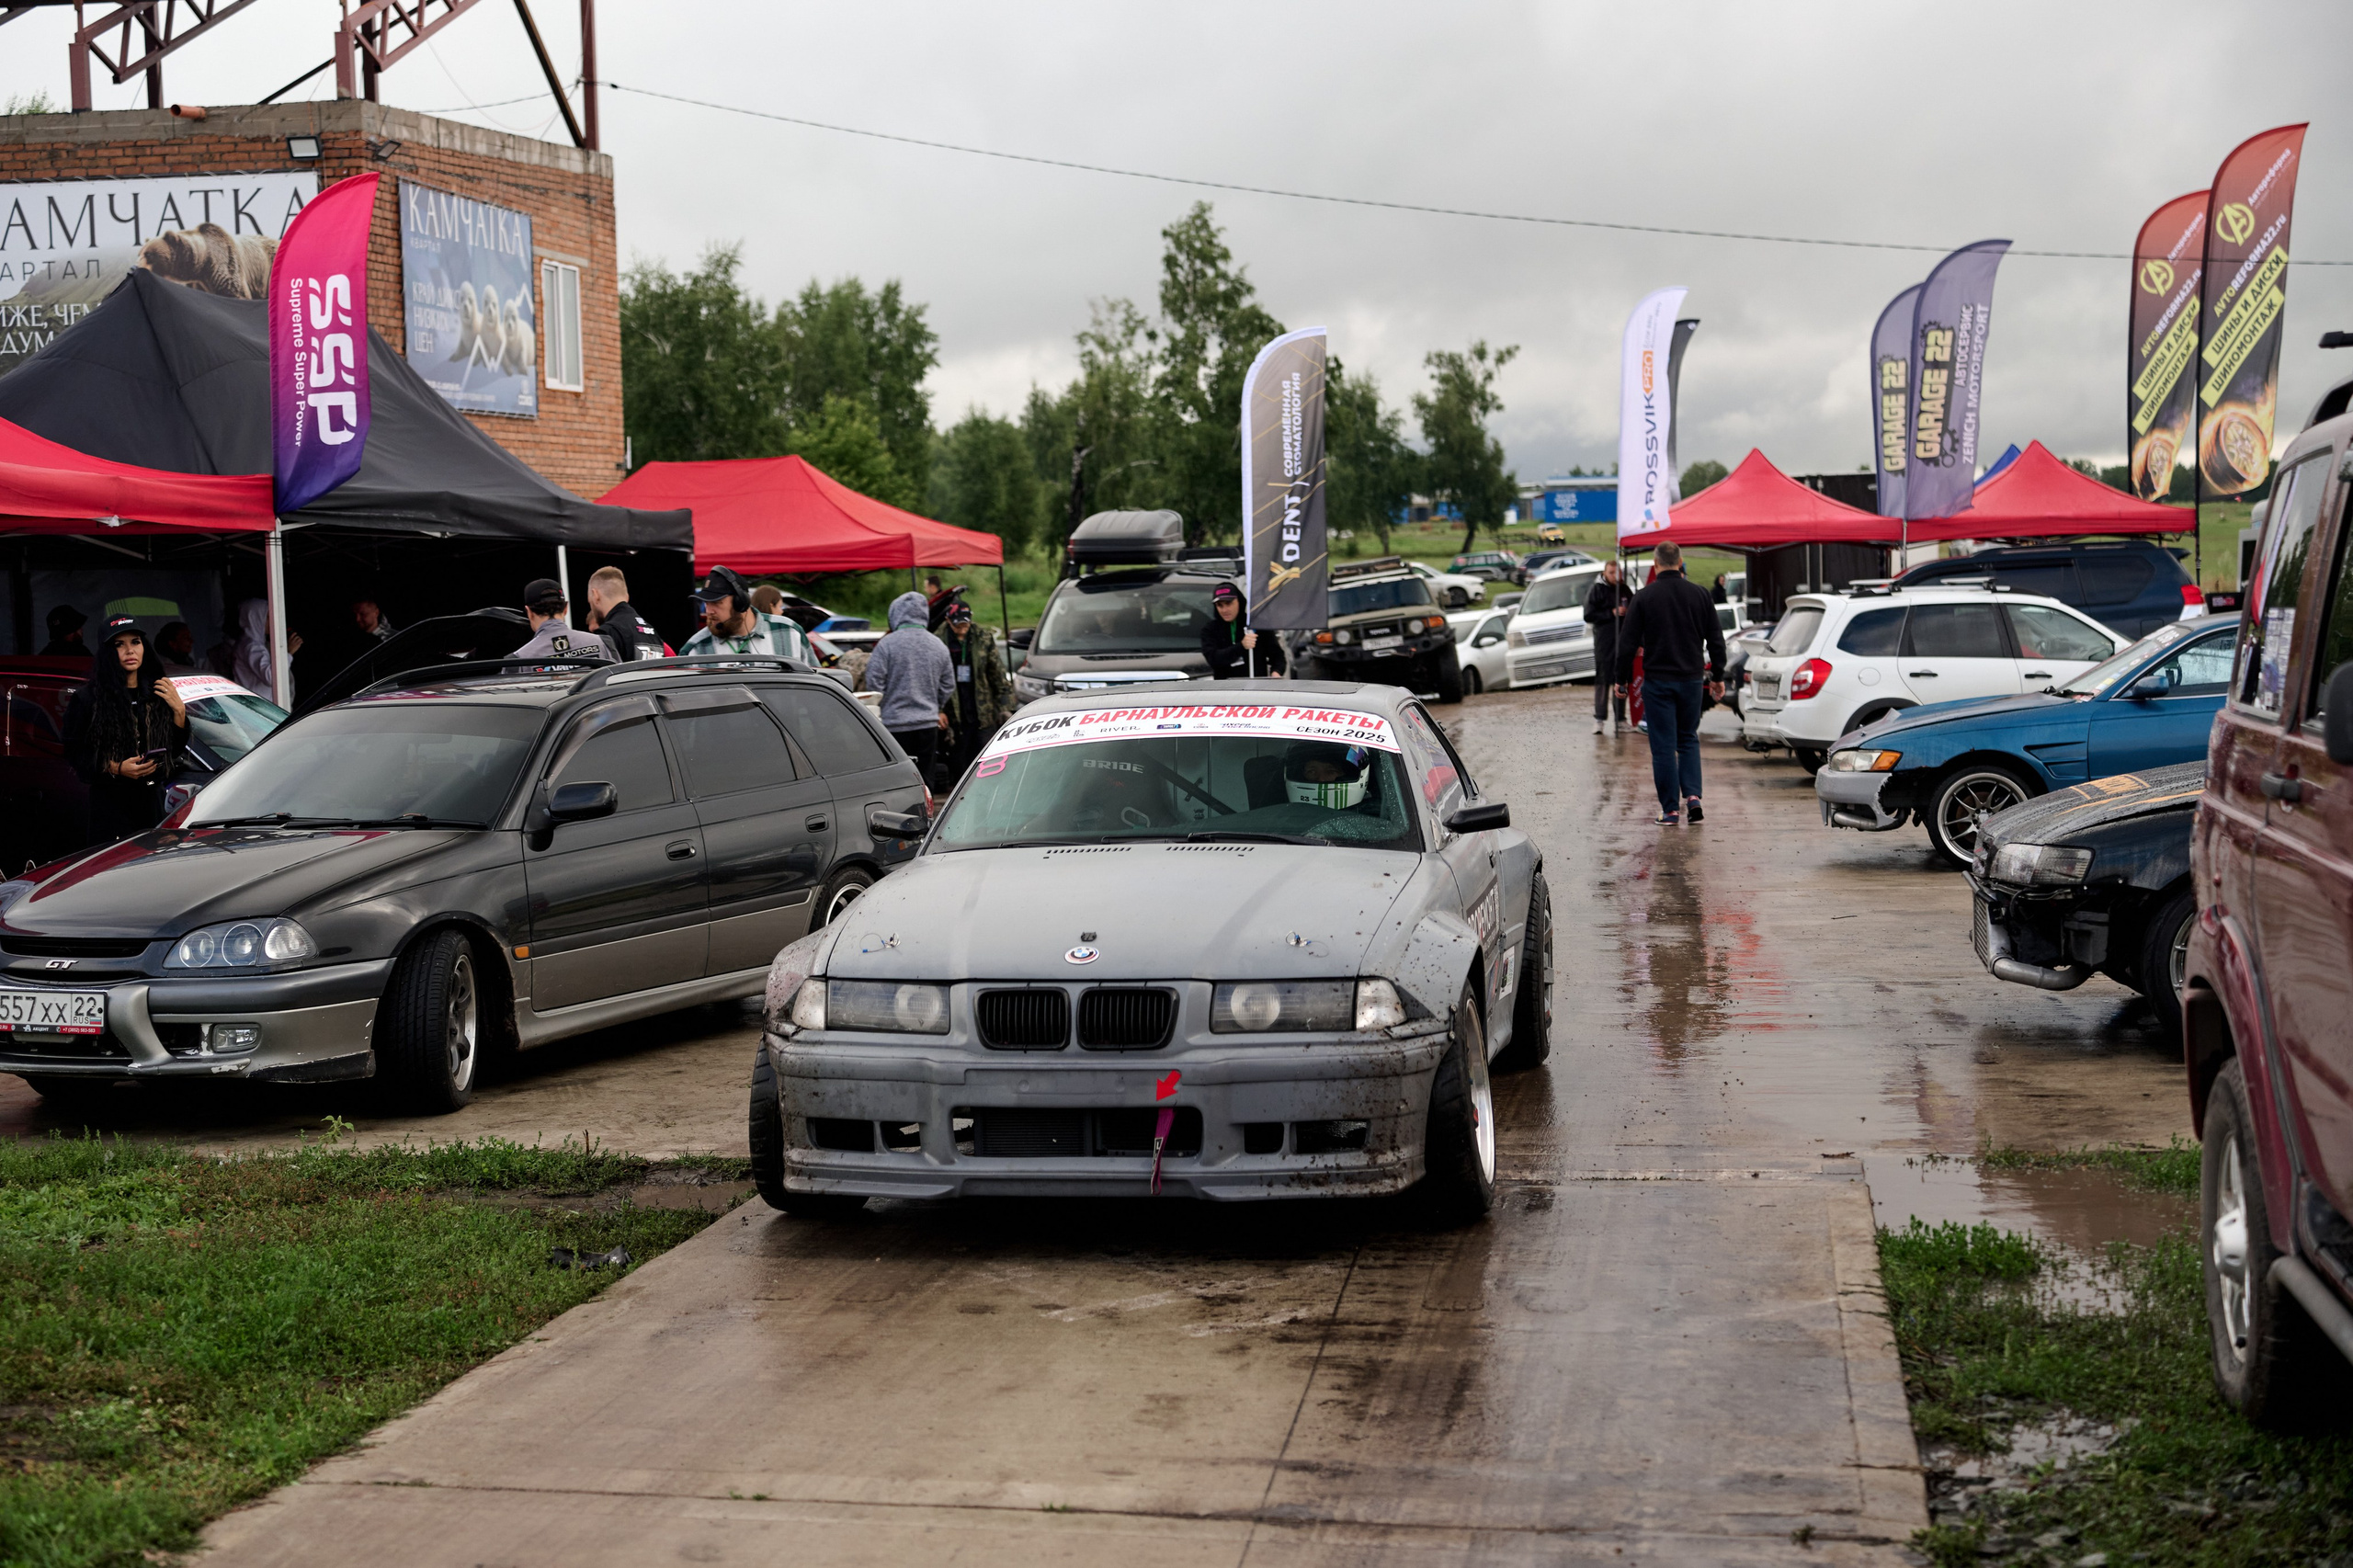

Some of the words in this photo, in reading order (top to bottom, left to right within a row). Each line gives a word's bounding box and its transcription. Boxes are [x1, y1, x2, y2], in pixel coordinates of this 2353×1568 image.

[408, 184, 525, 257] КАМЧАТКА
[2213, 214, 2287, 318] AVTOREFORMA22.ru
[289, 278, 304, 348] Supreme
[2212, 312, 2243, 355] ШИНЫ
[2241, 299, 2252, 313] И
[2251, 254, 2282, 301] ДИСКИ
[293, 351, 307, 396] Super
[307, 274, 358, 446] SSP
[1882, 359, 1906, 389] 22
[1925, 329, 1954, 362] 22
[1954, 303, 1974, 387] АВТОСЕРВИС
[1967, 303, 1989, 408] MOTORSPORT
[2141, 351, 2167, 390] ШИНЫ
[2211, 298, 2279, 392] ШИНОМОНТАЖ
[1915, 369, 1949, 459] GARAGE
[2142, 341, 2192, 422] ШИНОМОНТАЖ
[295, 401, 306, 447] Power
[1281, 381, 1294, 477] СОВРЕМЕННАЯ
[1291, 372, 1302, 475] СТОМАТОЛОГИЯ
[1644, 392, 1658, 506] ROSSVIK
[1882, 392, 1906, 472] GARAGE
[1962, 413, 1977, 465] ZENICH
[563, 645, 599, 658] MOTORS
[996, 715, 1077, 742] КУБОК
[1079, 706, 1278, 725] БАРНАУЛЬСКОЙ
[1282, 707, 1385, 731] РАКЕТЫ
[1296, 726, 1341, 735] СЕЗОН
[1343, 729, 1386, 744] 2025
[1082, 758, 1145, 774] BRIDE
[45, 960, 79, 970] GT
[74, 996, 97, 1017] 22
